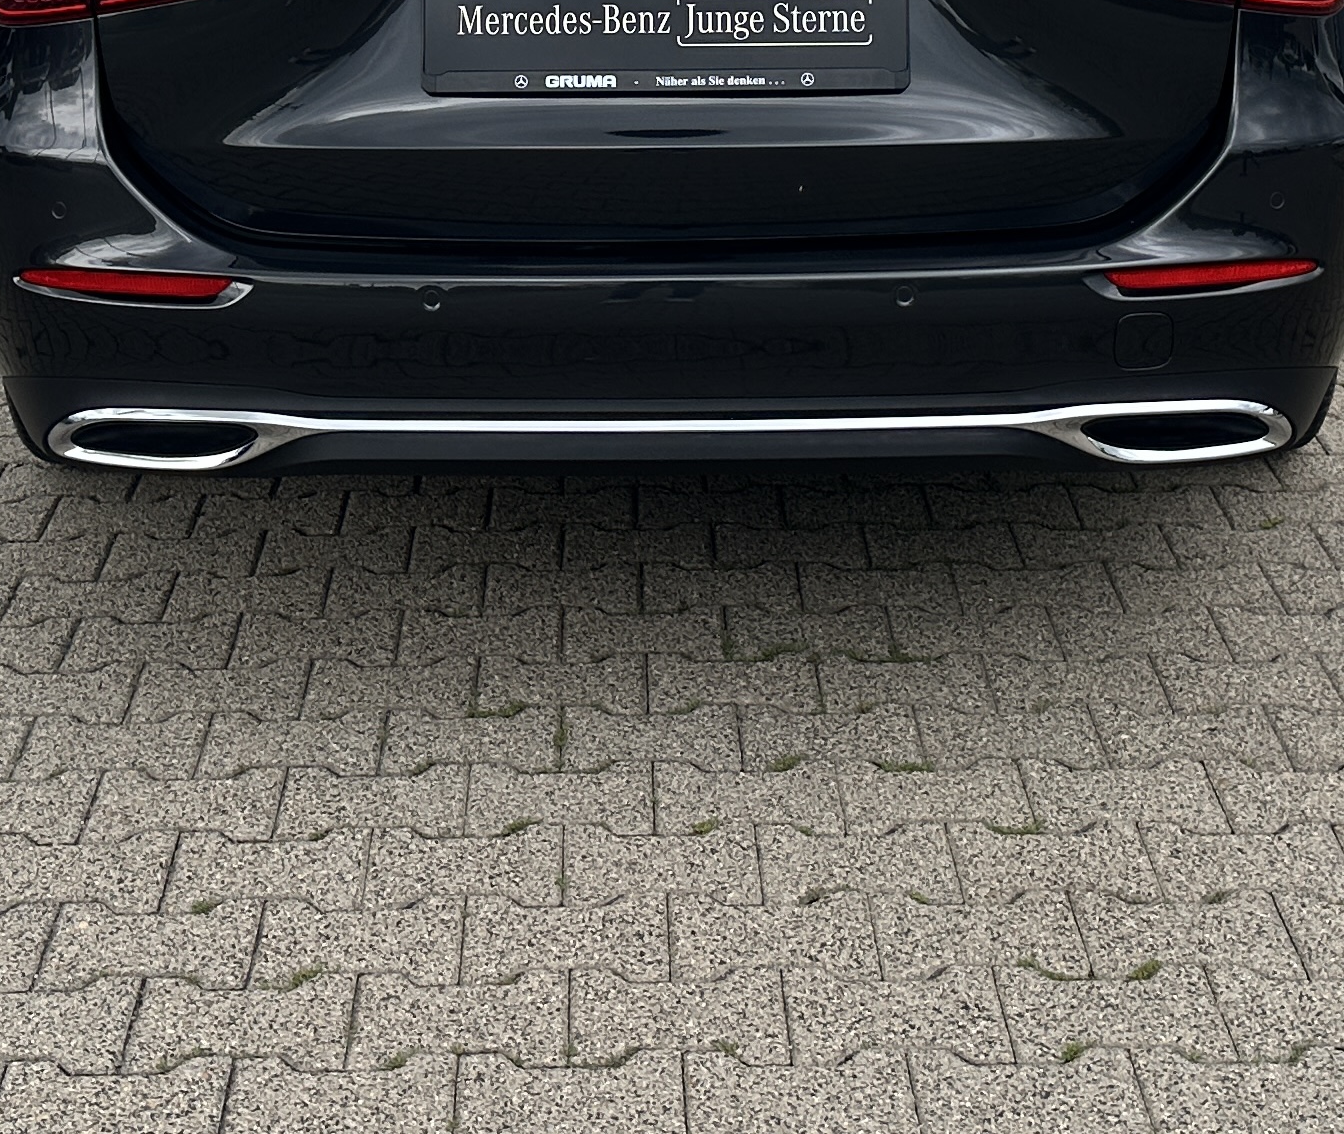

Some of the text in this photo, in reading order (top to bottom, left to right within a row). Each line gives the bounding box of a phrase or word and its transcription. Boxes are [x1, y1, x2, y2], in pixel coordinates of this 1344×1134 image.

[456, 1, 866, 41] Mercedes-Benz Junge Sterne
[544, 74, 617, 89] GRUMA
[655, 75, 689, 87] Näher
[691, 75, 707, 86] als
[708, 75, 725, 87] Sie
[727, 75, 766, 86] denken
